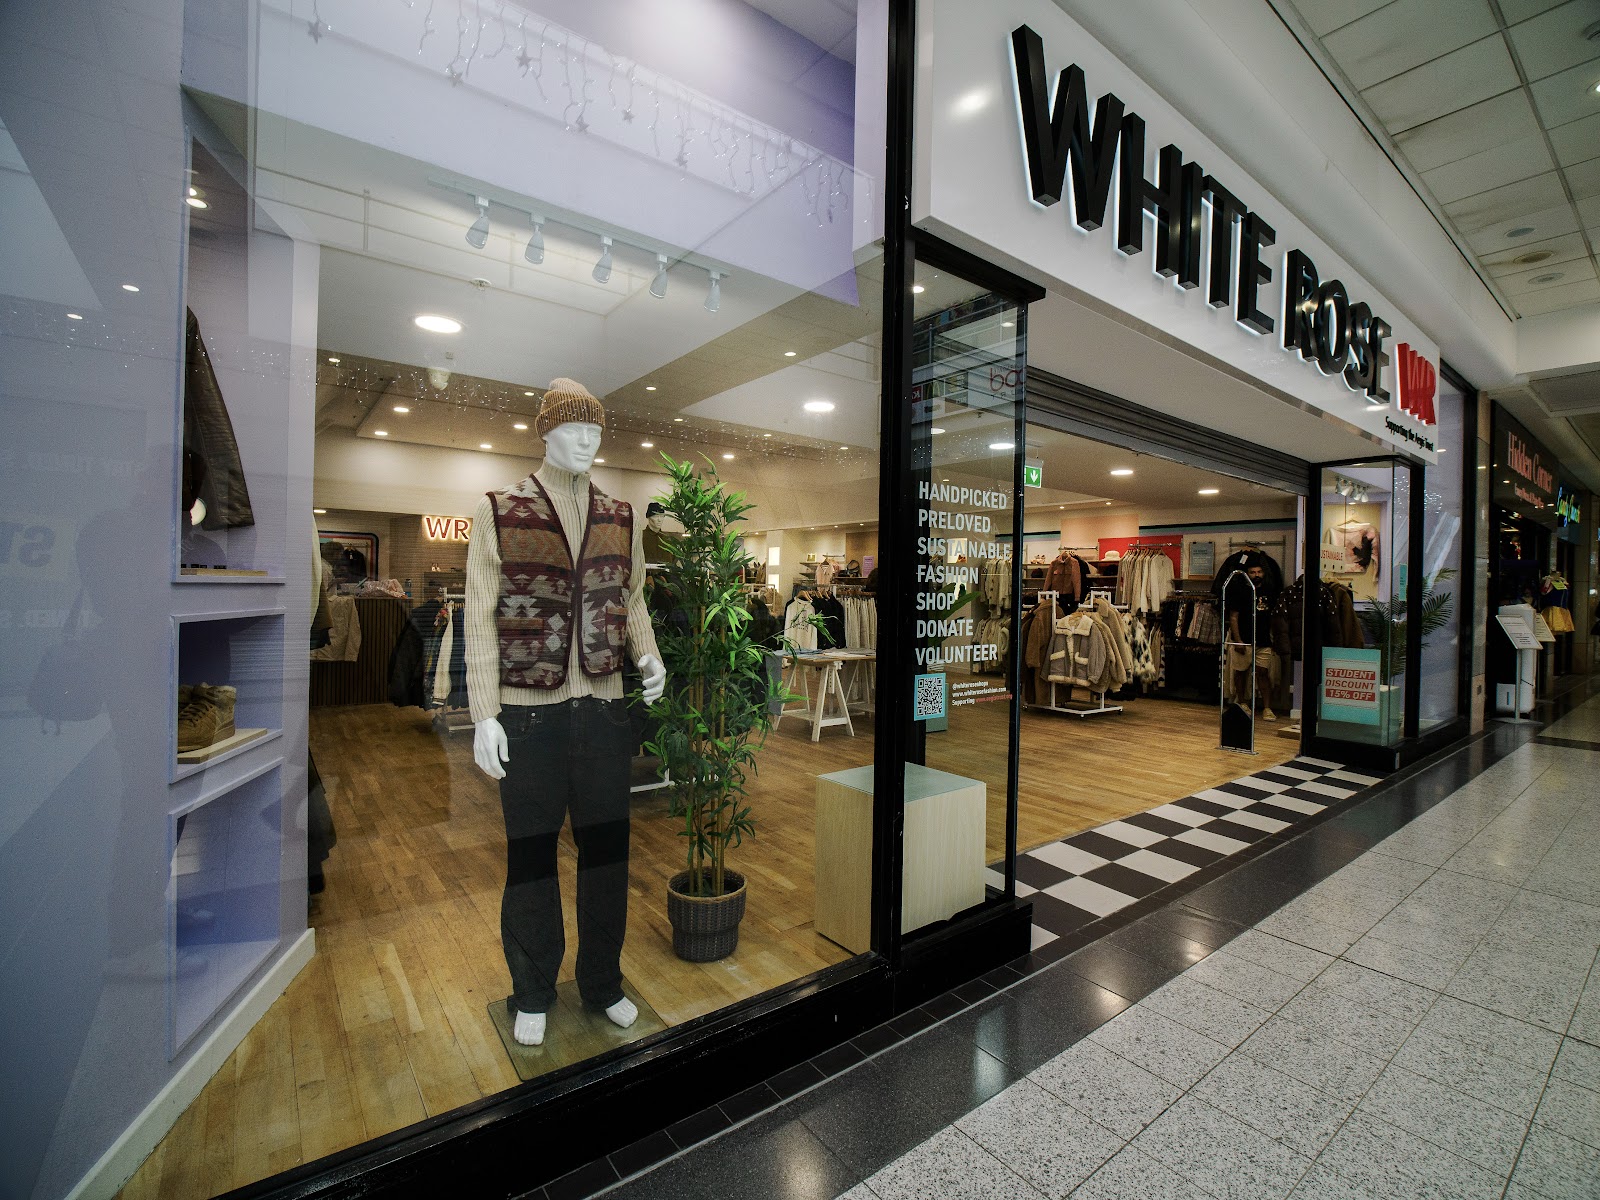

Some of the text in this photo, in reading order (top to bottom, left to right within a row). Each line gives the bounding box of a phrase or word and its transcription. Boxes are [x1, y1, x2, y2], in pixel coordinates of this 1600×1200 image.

[1010, 23, 1392, 404] WHITE ROSE
[1395, 342, 1437, 426] WR
[918, 480, 1007, 510] HANDPICKED
[426, 518, 468, 539] WR
[918, 508, 991, 533] PRELOVED
[917, 536, 1011, 560] SUSTAINABLE
[917, 564, 979, 584] FASHION
[916, 592, 956, 611] SHOP
[916, 619, 974, 639] DONATE
[915, 643, 998, 666] VOLUNTEER
[1325, 679, 1376, 690] DISCOUNT
[1326, 668, 1374, 680] STUDENT
[1329, 689, 1373, 701] 15% OFF
